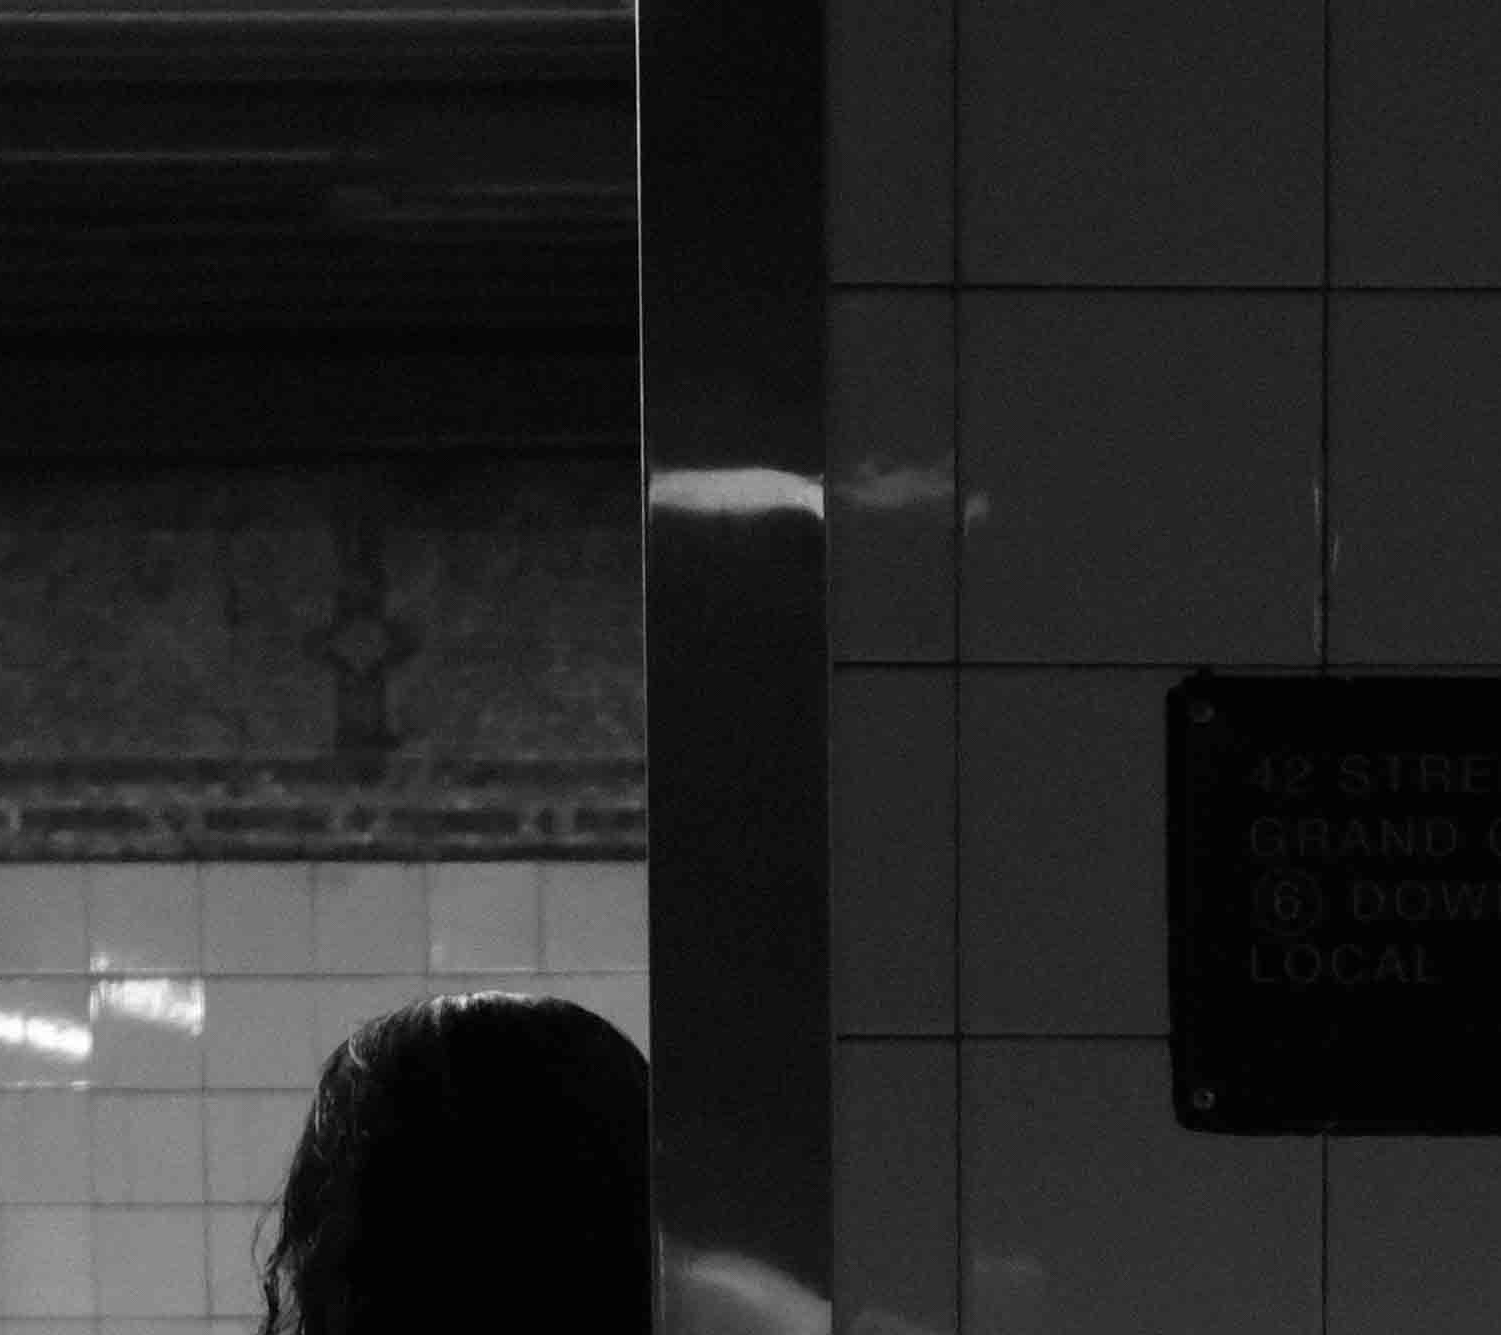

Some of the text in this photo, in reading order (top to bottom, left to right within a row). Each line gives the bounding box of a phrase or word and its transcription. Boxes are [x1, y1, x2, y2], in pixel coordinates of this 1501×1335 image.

[1250, 753, 1315, 795] 42
[1249, 816, 1460, 858] GRAND
[1249, 943, 1442, 986] LOCAL
